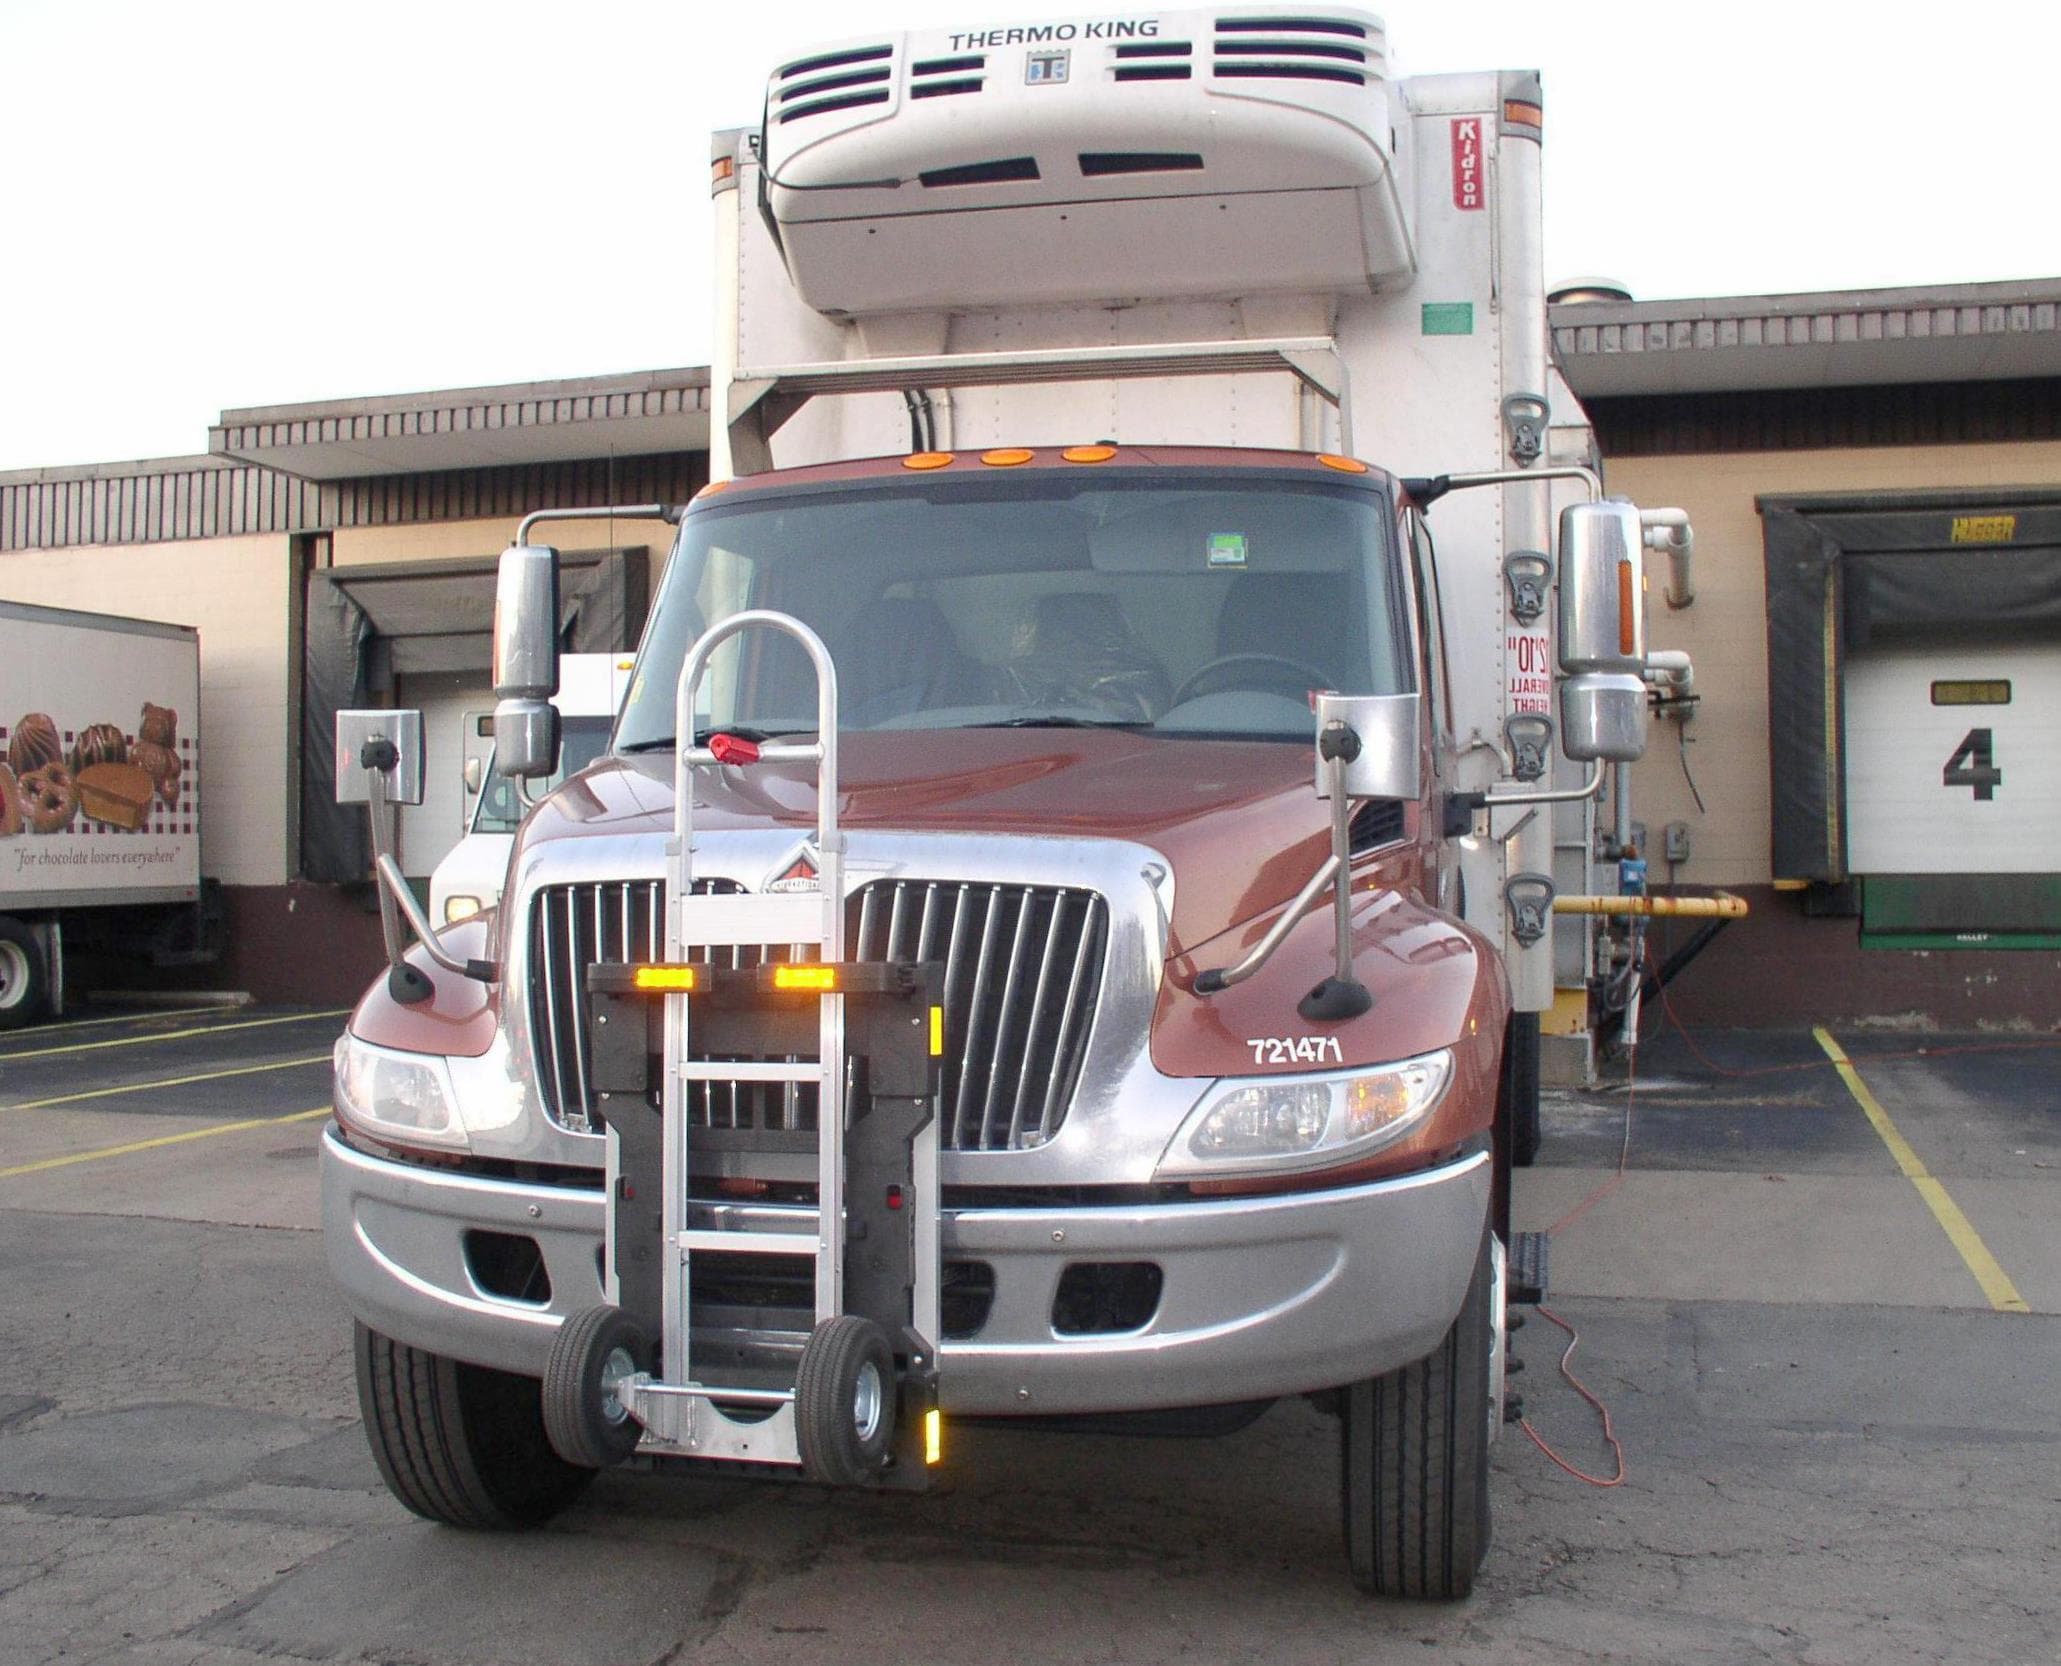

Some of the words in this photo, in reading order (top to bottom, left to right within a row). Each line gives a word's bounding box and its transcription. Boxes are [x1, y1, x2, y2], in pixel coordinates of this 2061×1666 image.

[949, 24, 1077, 51] THERMO
[1085, 19, 1159, 39] KING
[1458, 121, 1477, 206] Kidron
[1943, 728, 2001, 800] 4
[14, 848, 38, 872] "for
[38, 848, 88, 865] chocolate
[90, 848, 122, 864] lovers
[122, 847, 181, 870] everywhere"
[1246, 1036, 1343, 1065] 721471
